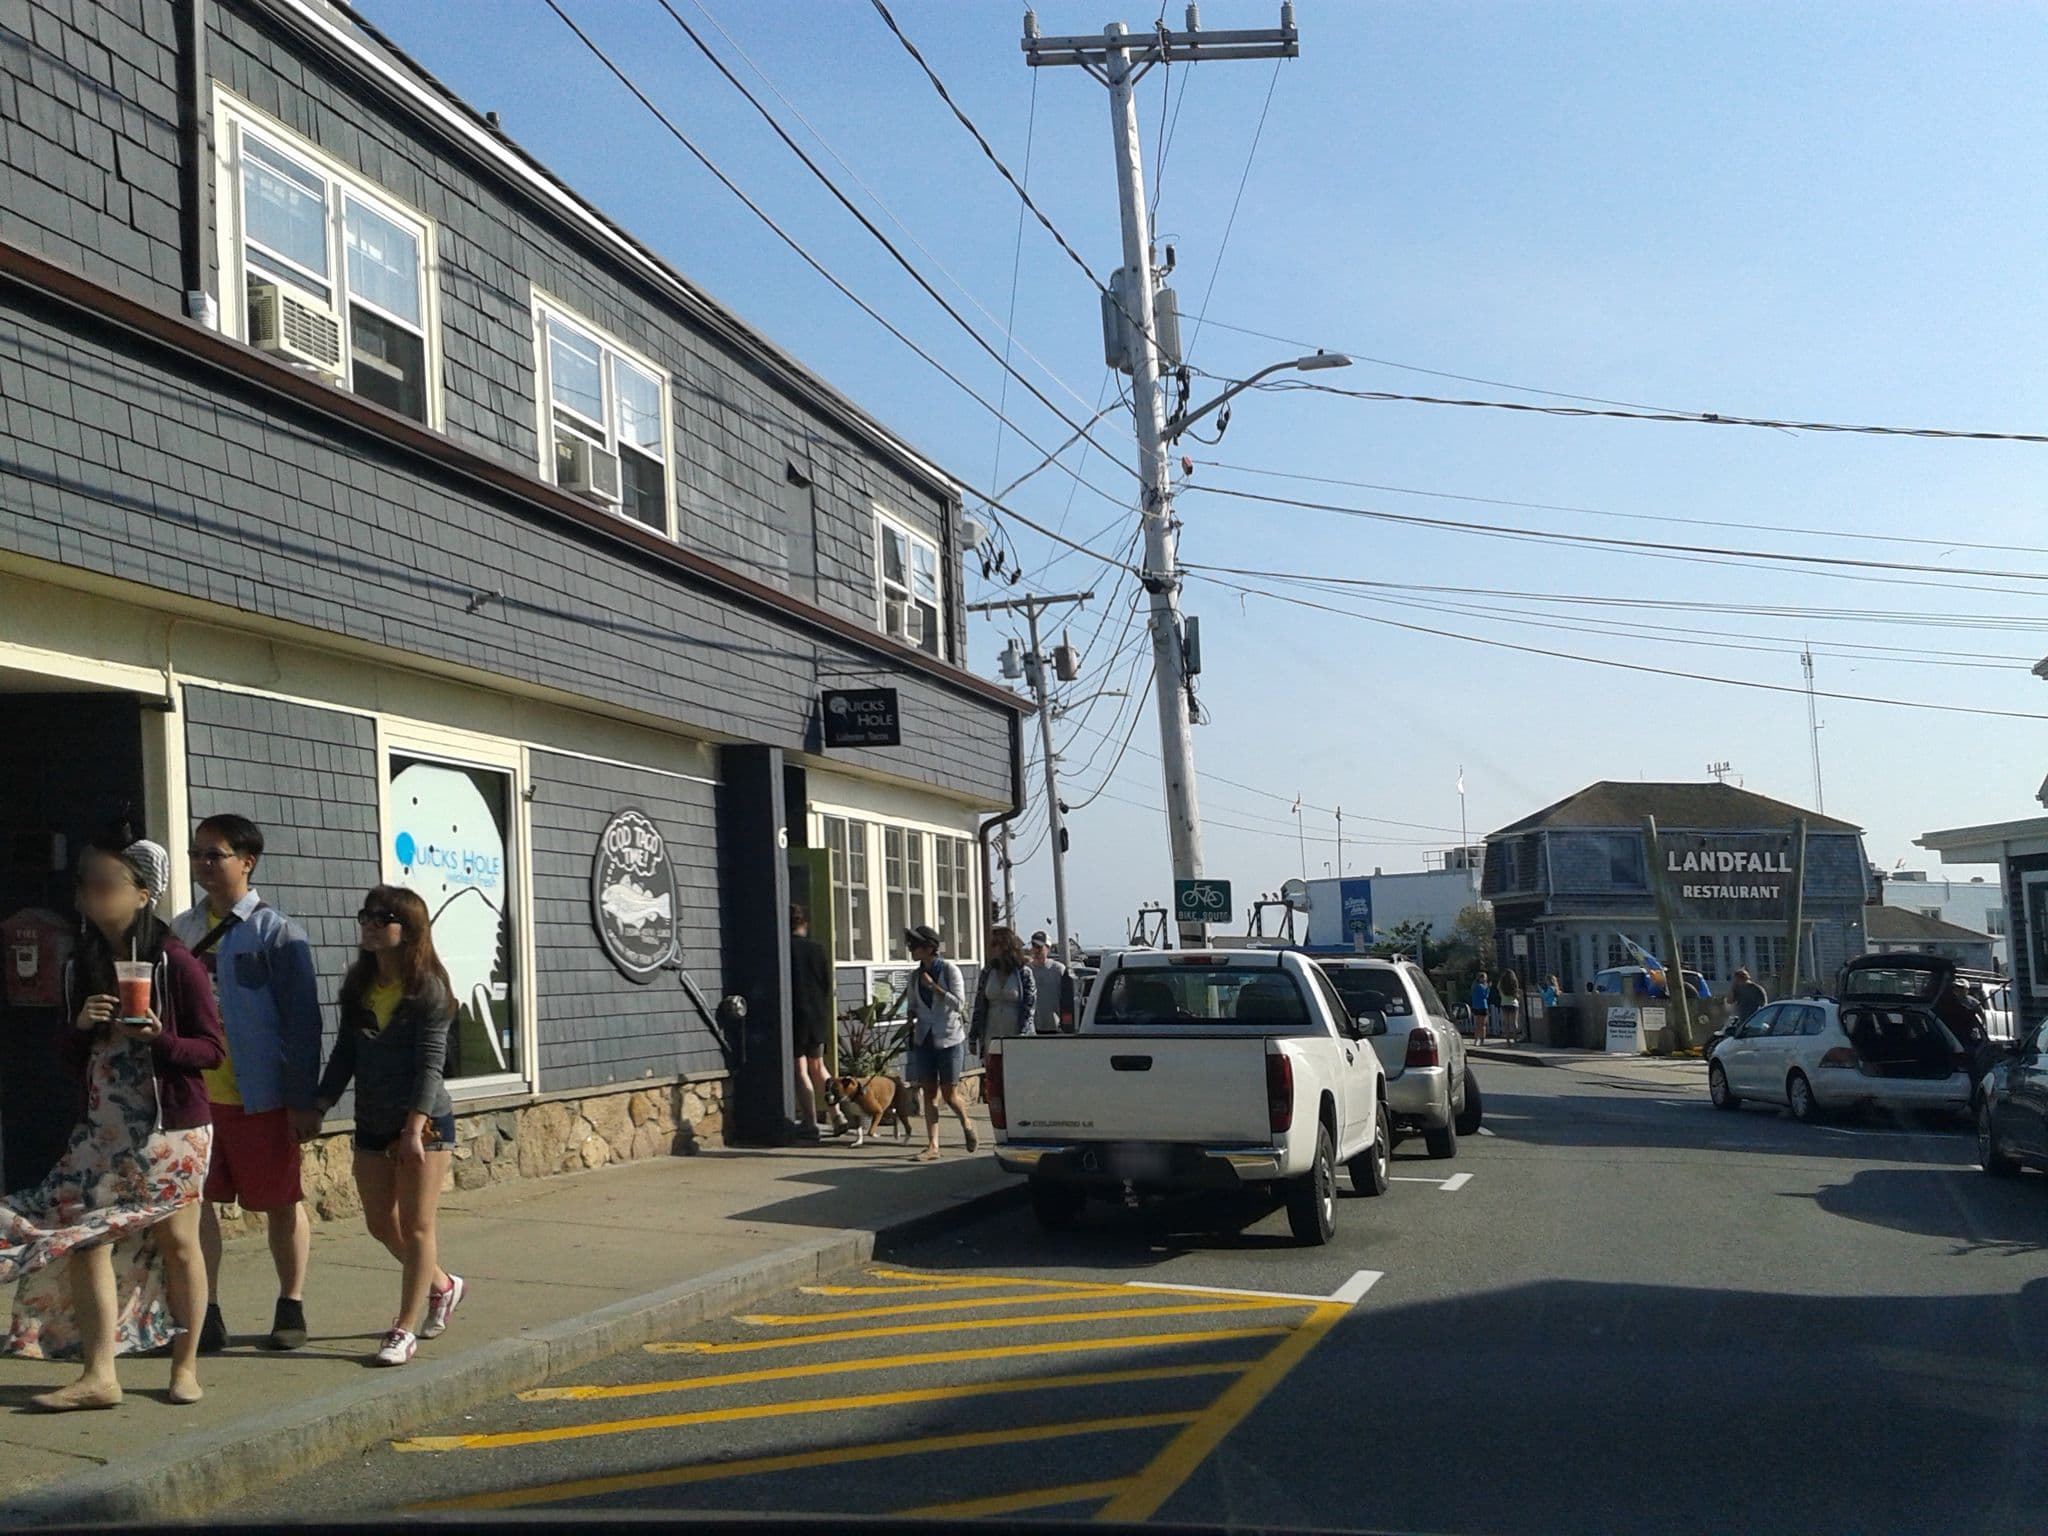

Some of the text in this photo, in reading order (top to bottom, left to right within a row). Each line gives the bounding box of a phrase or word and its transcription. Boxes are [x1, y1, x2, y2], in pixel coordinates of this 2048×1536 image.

[857, 714, 894, 727] HOLE
[609, 825, 659, 854] COD TACO
[463, 848, 499, 875] HOLE
[1667, 850, 1793, 873] LANDFALL
[1683, 884, 1781, 899] RESTAURANT
[1178, 911, 1229, 921] BIKE ROUTE
[1032, 1120, 1081, 1128] COLORADO
